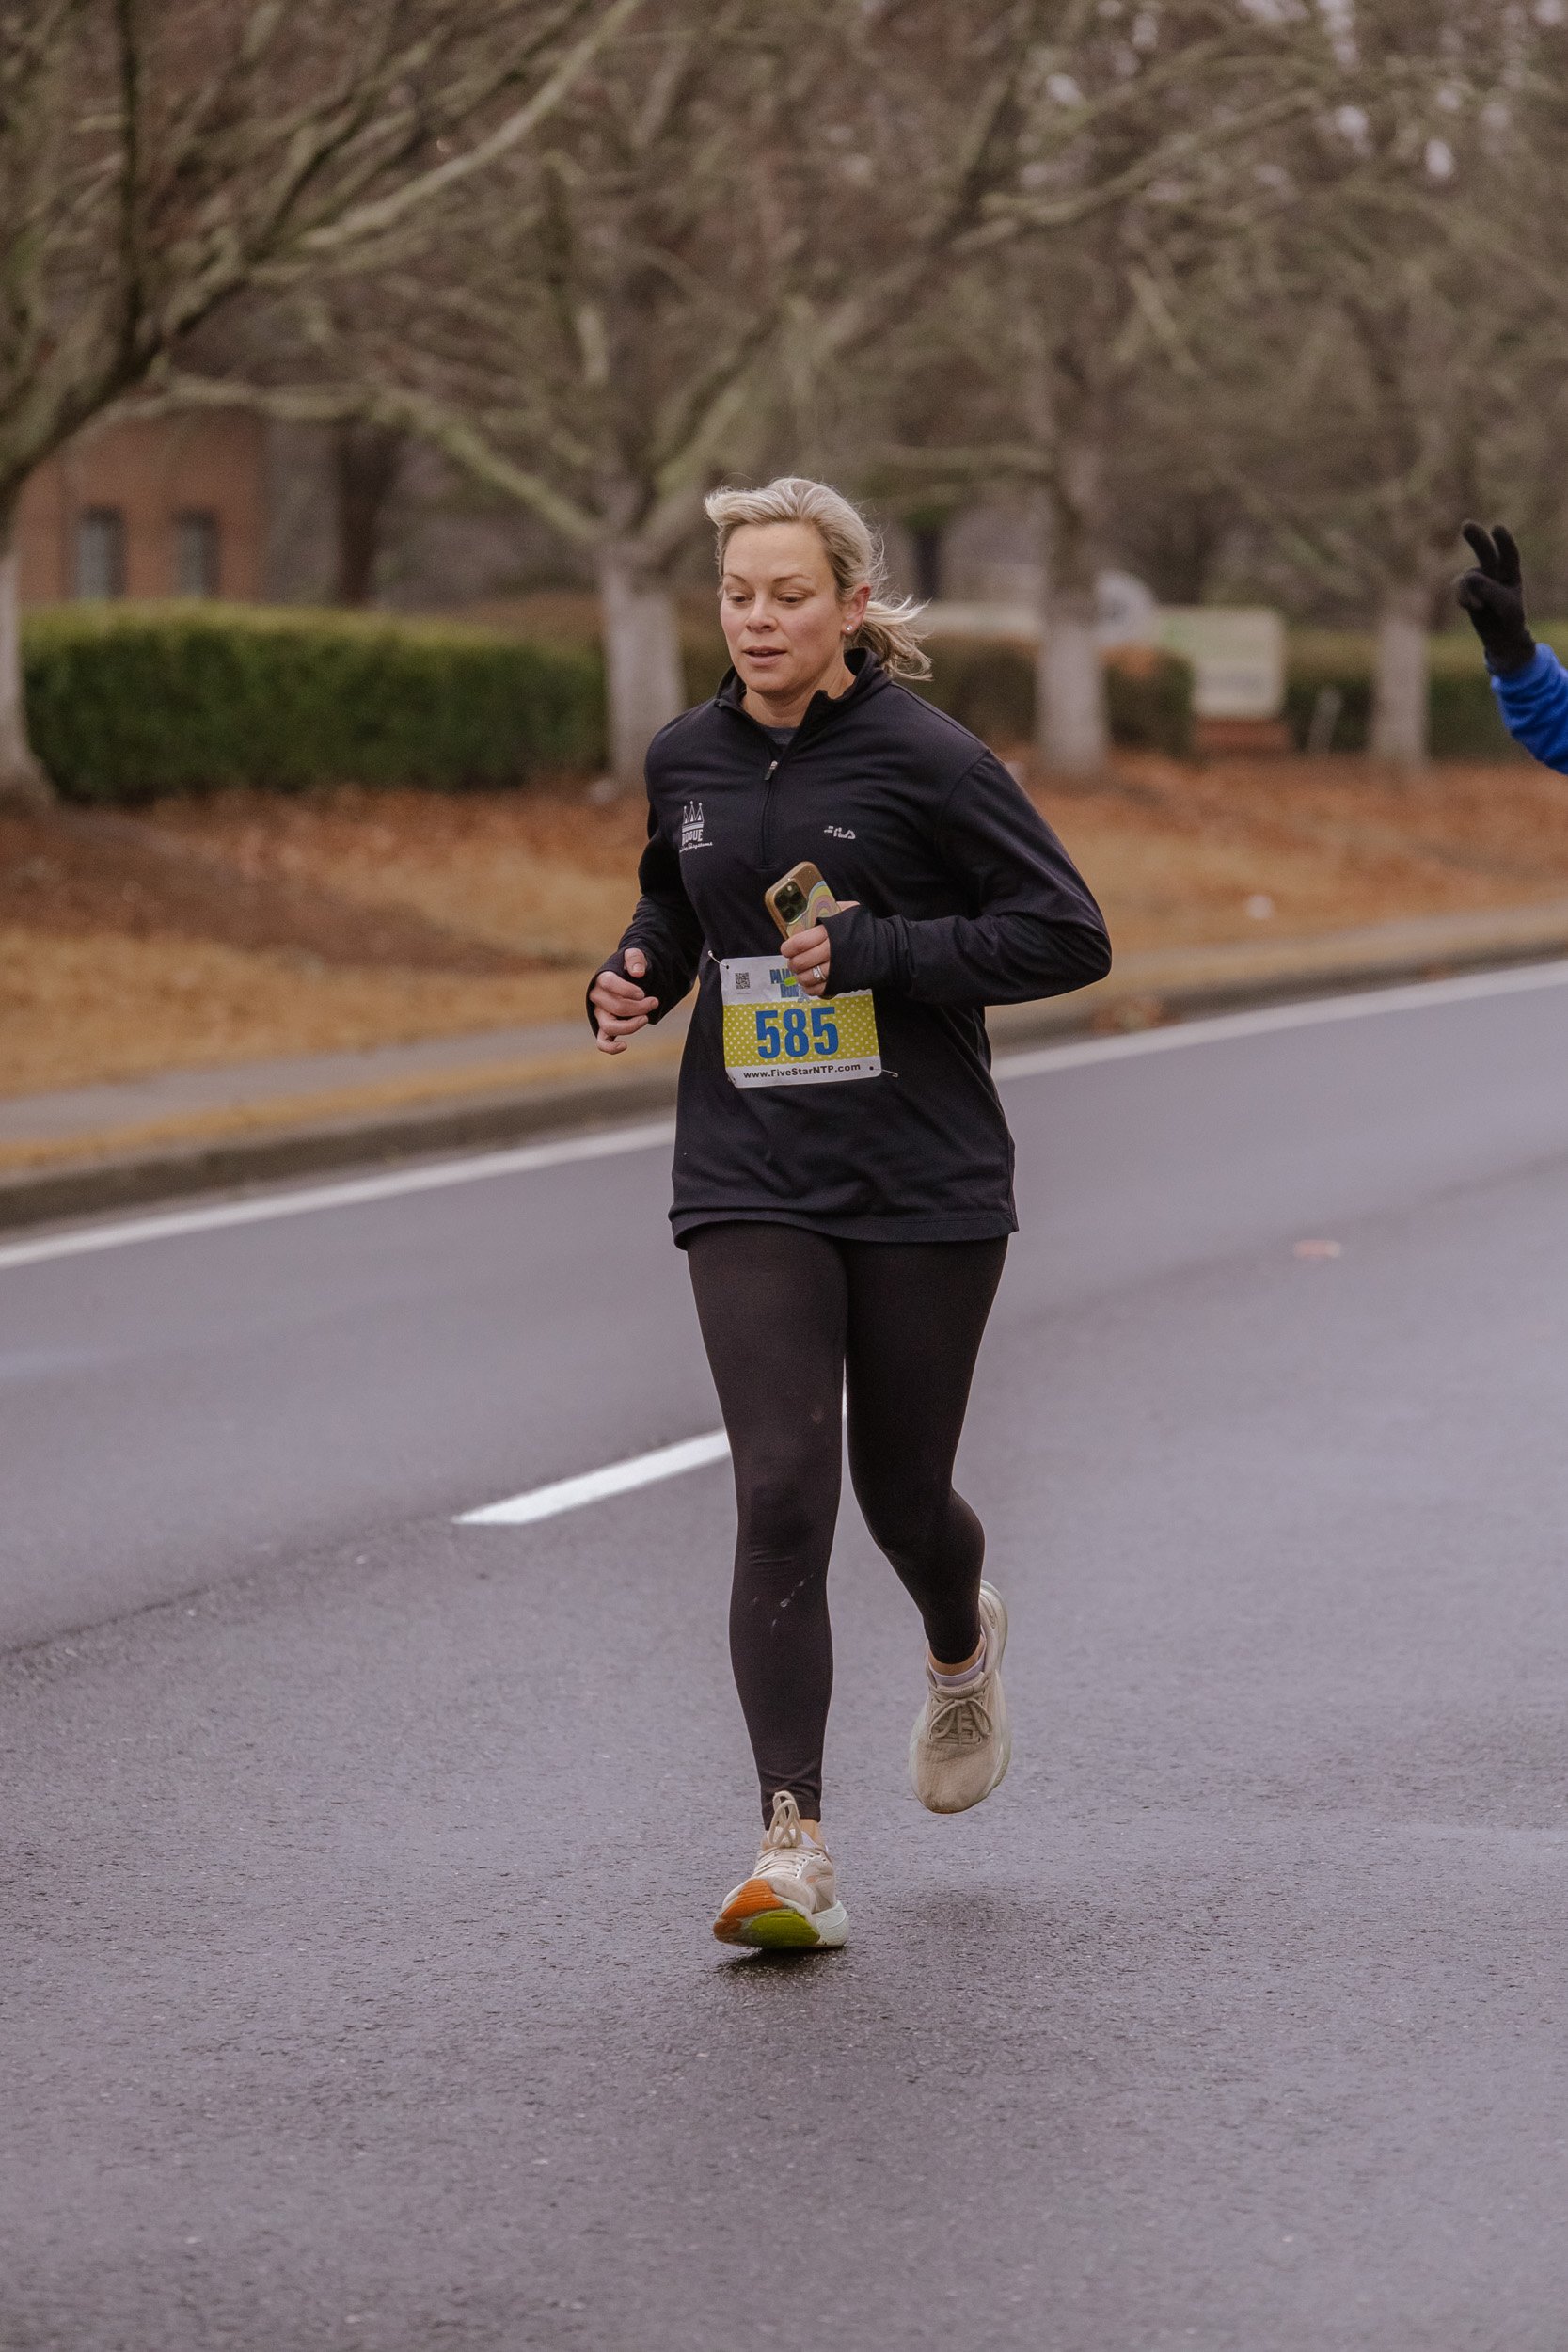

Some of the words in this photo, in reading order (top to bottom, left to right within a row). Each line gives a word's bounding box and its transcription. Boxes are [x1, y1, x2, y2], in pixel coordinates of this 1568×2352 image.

[681, 829, 704, 847] ROGUE
[823, 825, 856, 840] FILA
[755, 1006, 839, 1059] 585
[743, 1063, 861, 1079] www.FiveStarNTP.com
